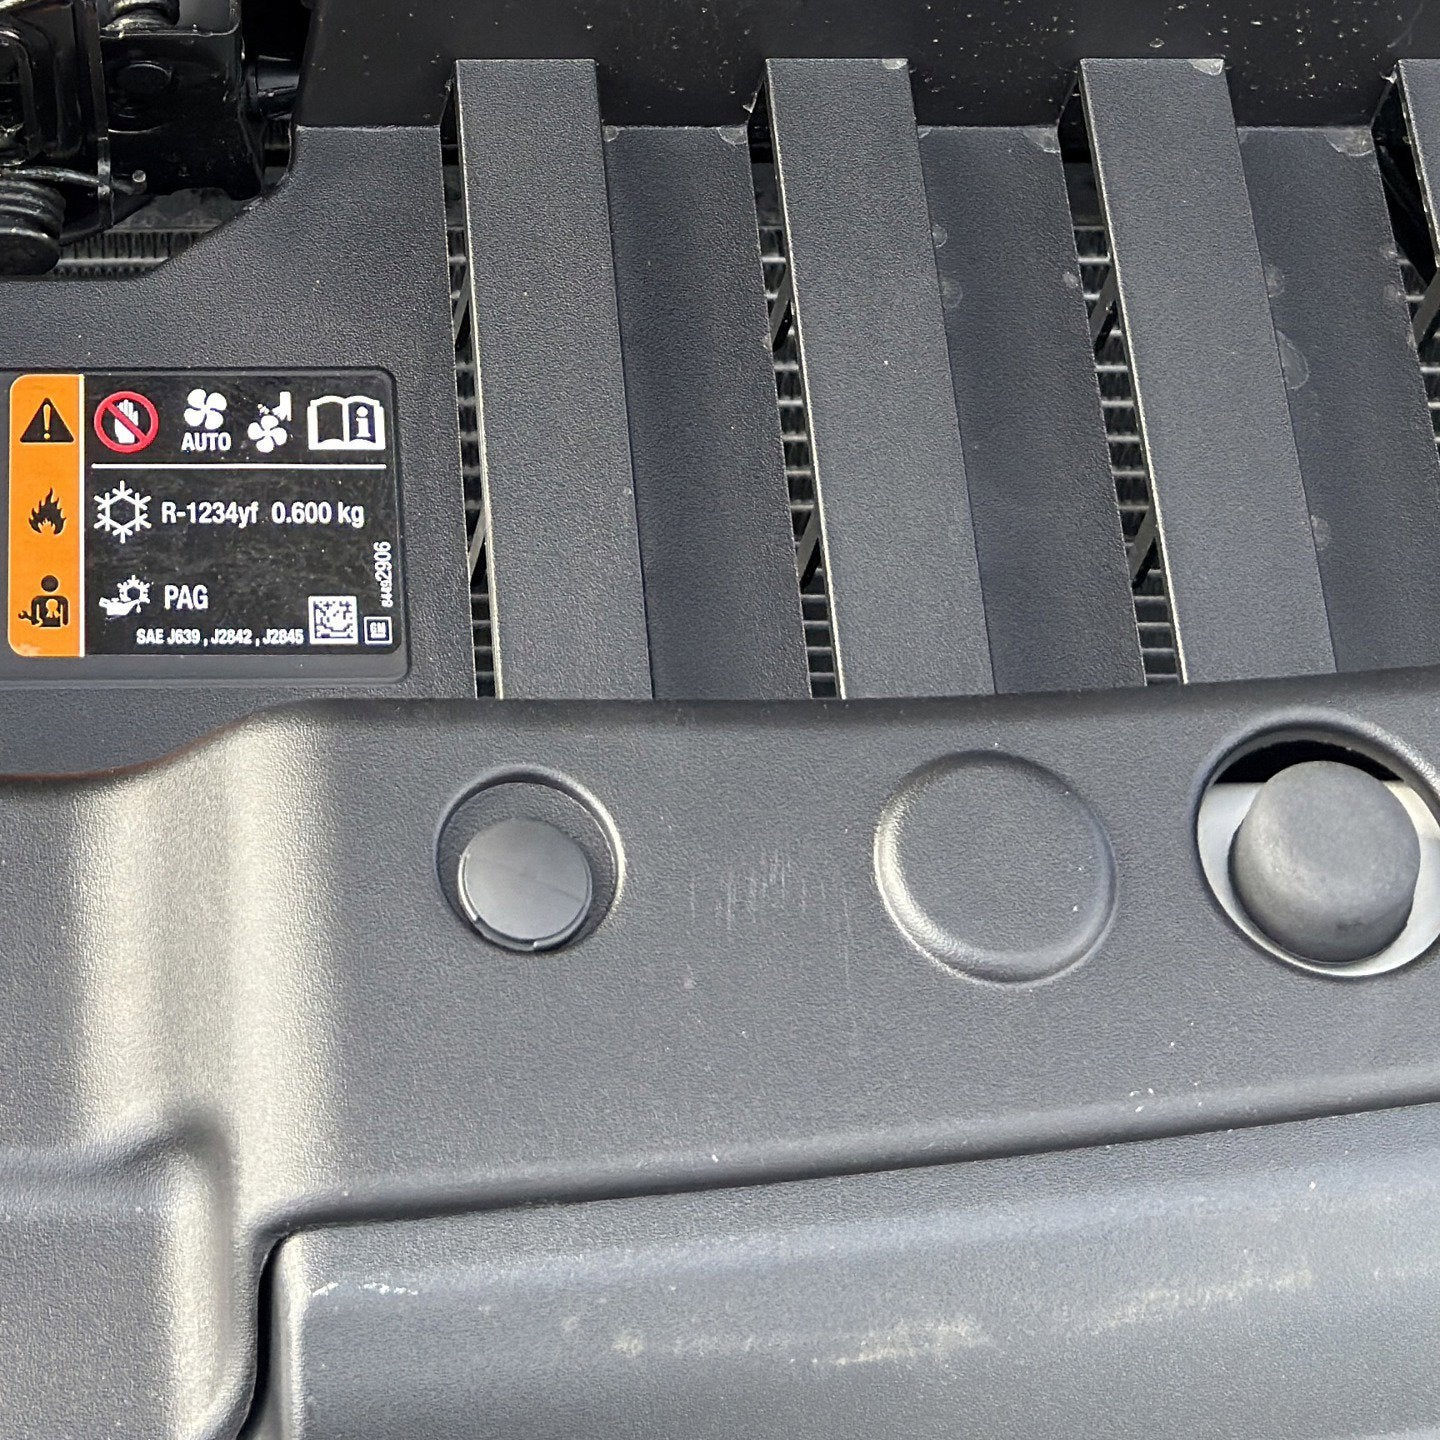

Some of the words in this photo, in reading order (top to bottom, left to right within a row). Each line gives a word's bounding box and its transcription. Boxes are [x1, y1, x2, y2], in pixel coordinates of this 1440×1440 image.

[180, 431, 232, 452] AUTO
[161, 500, 259, 529] R-1234yf
[271, 501, 333, 525] 0.600
[337, 501, 365, 529] kg
[164, 584, 209, 610] PAG
[136, 627, 165, 645] SAE
[263, 628, 305, 645] J2845
